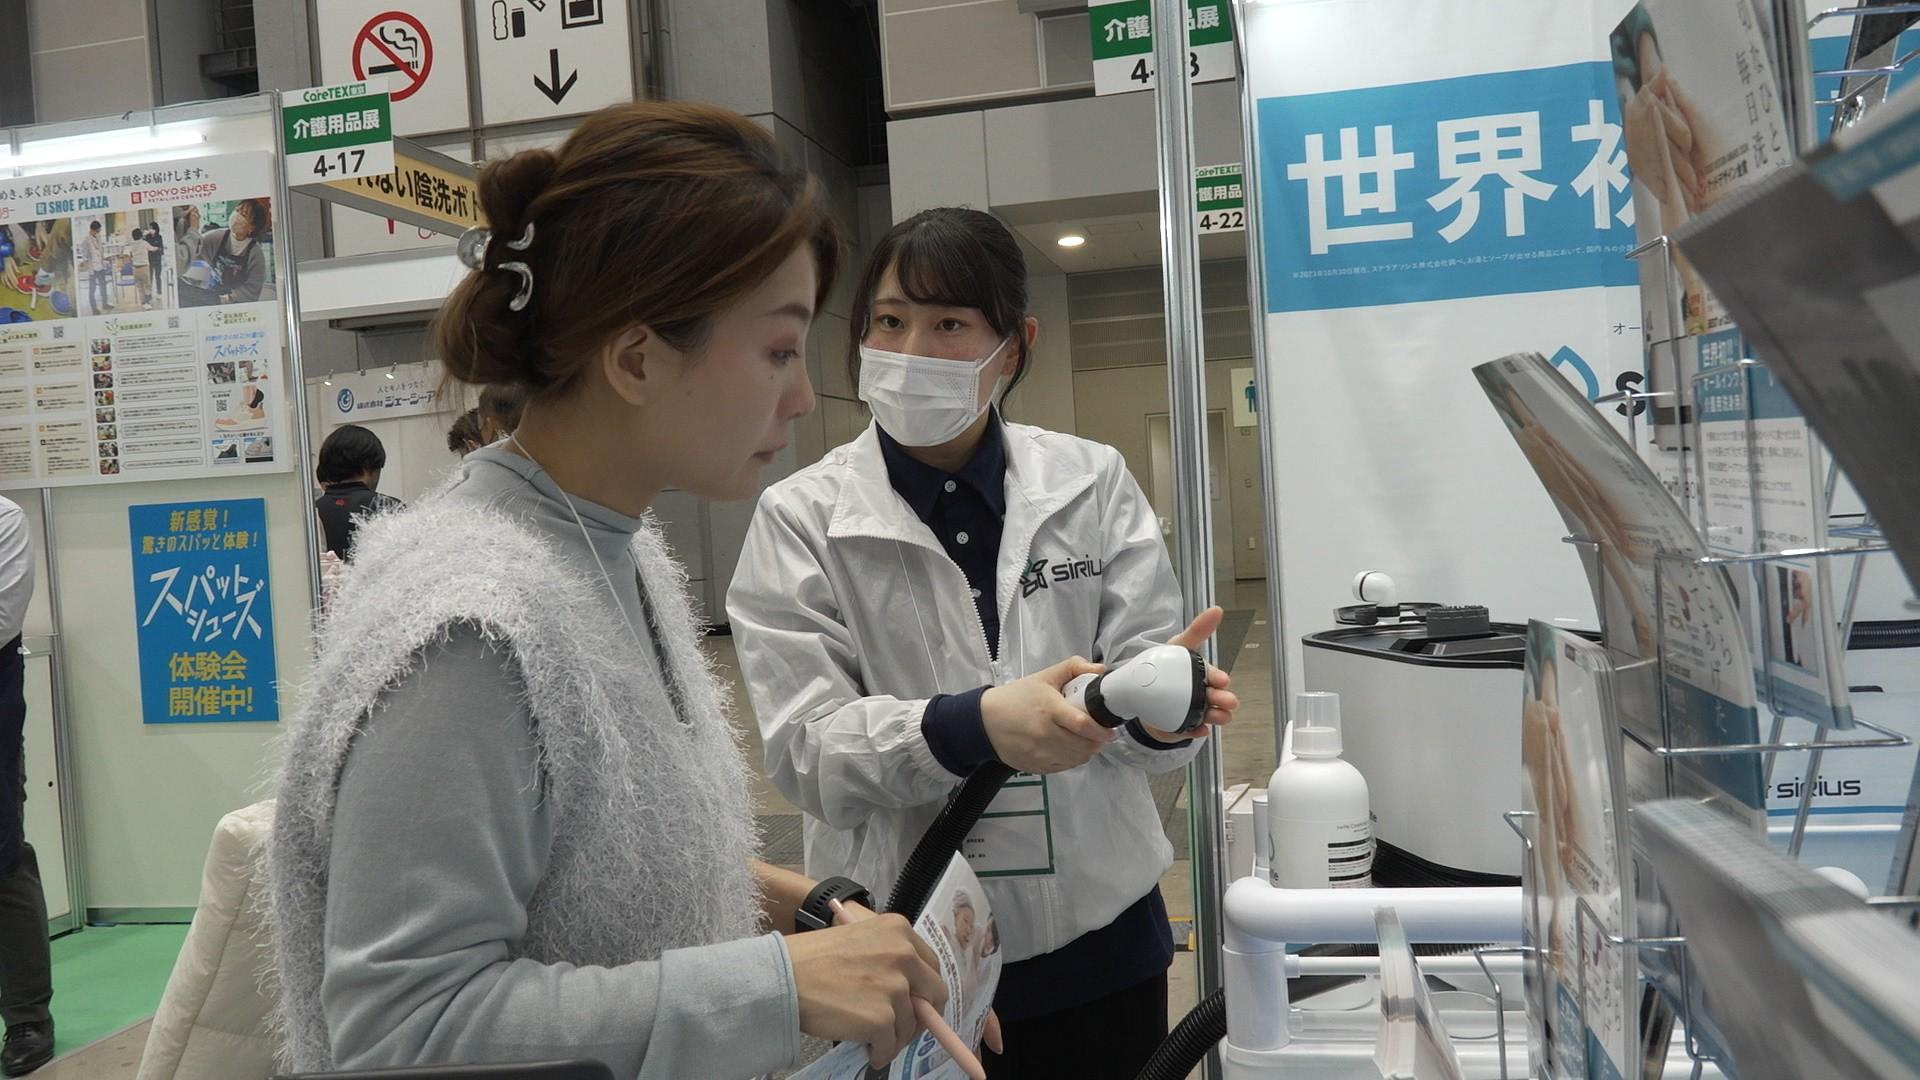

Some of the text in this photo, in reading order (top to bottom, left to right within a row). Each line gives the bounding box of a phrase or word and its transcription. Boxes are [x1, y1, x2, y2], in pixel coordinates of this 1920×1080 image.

[1103, 5, 1220, 42] 介護展
[303, 84, 349, 102] CareTEX
[293, 108, 380, 139] 介護用品展
[313, 149, 366, 177] 4-17
[48, 195, 109, 214] SHOE PLAZA
[143, 183, 217, 198] TOKYO SHOES
[1196, 184, 1243, 201] 護用品
[1200, 211, 1244, 230] 4-22
[169, 509, 229, 532] 新感覚！
[143, 564, 249, 627] スパット
[186, 579, 265, 643] シューズ
[169, 650, 249, 682] 体験会
[169, 685, 254, 717] 開催中!
